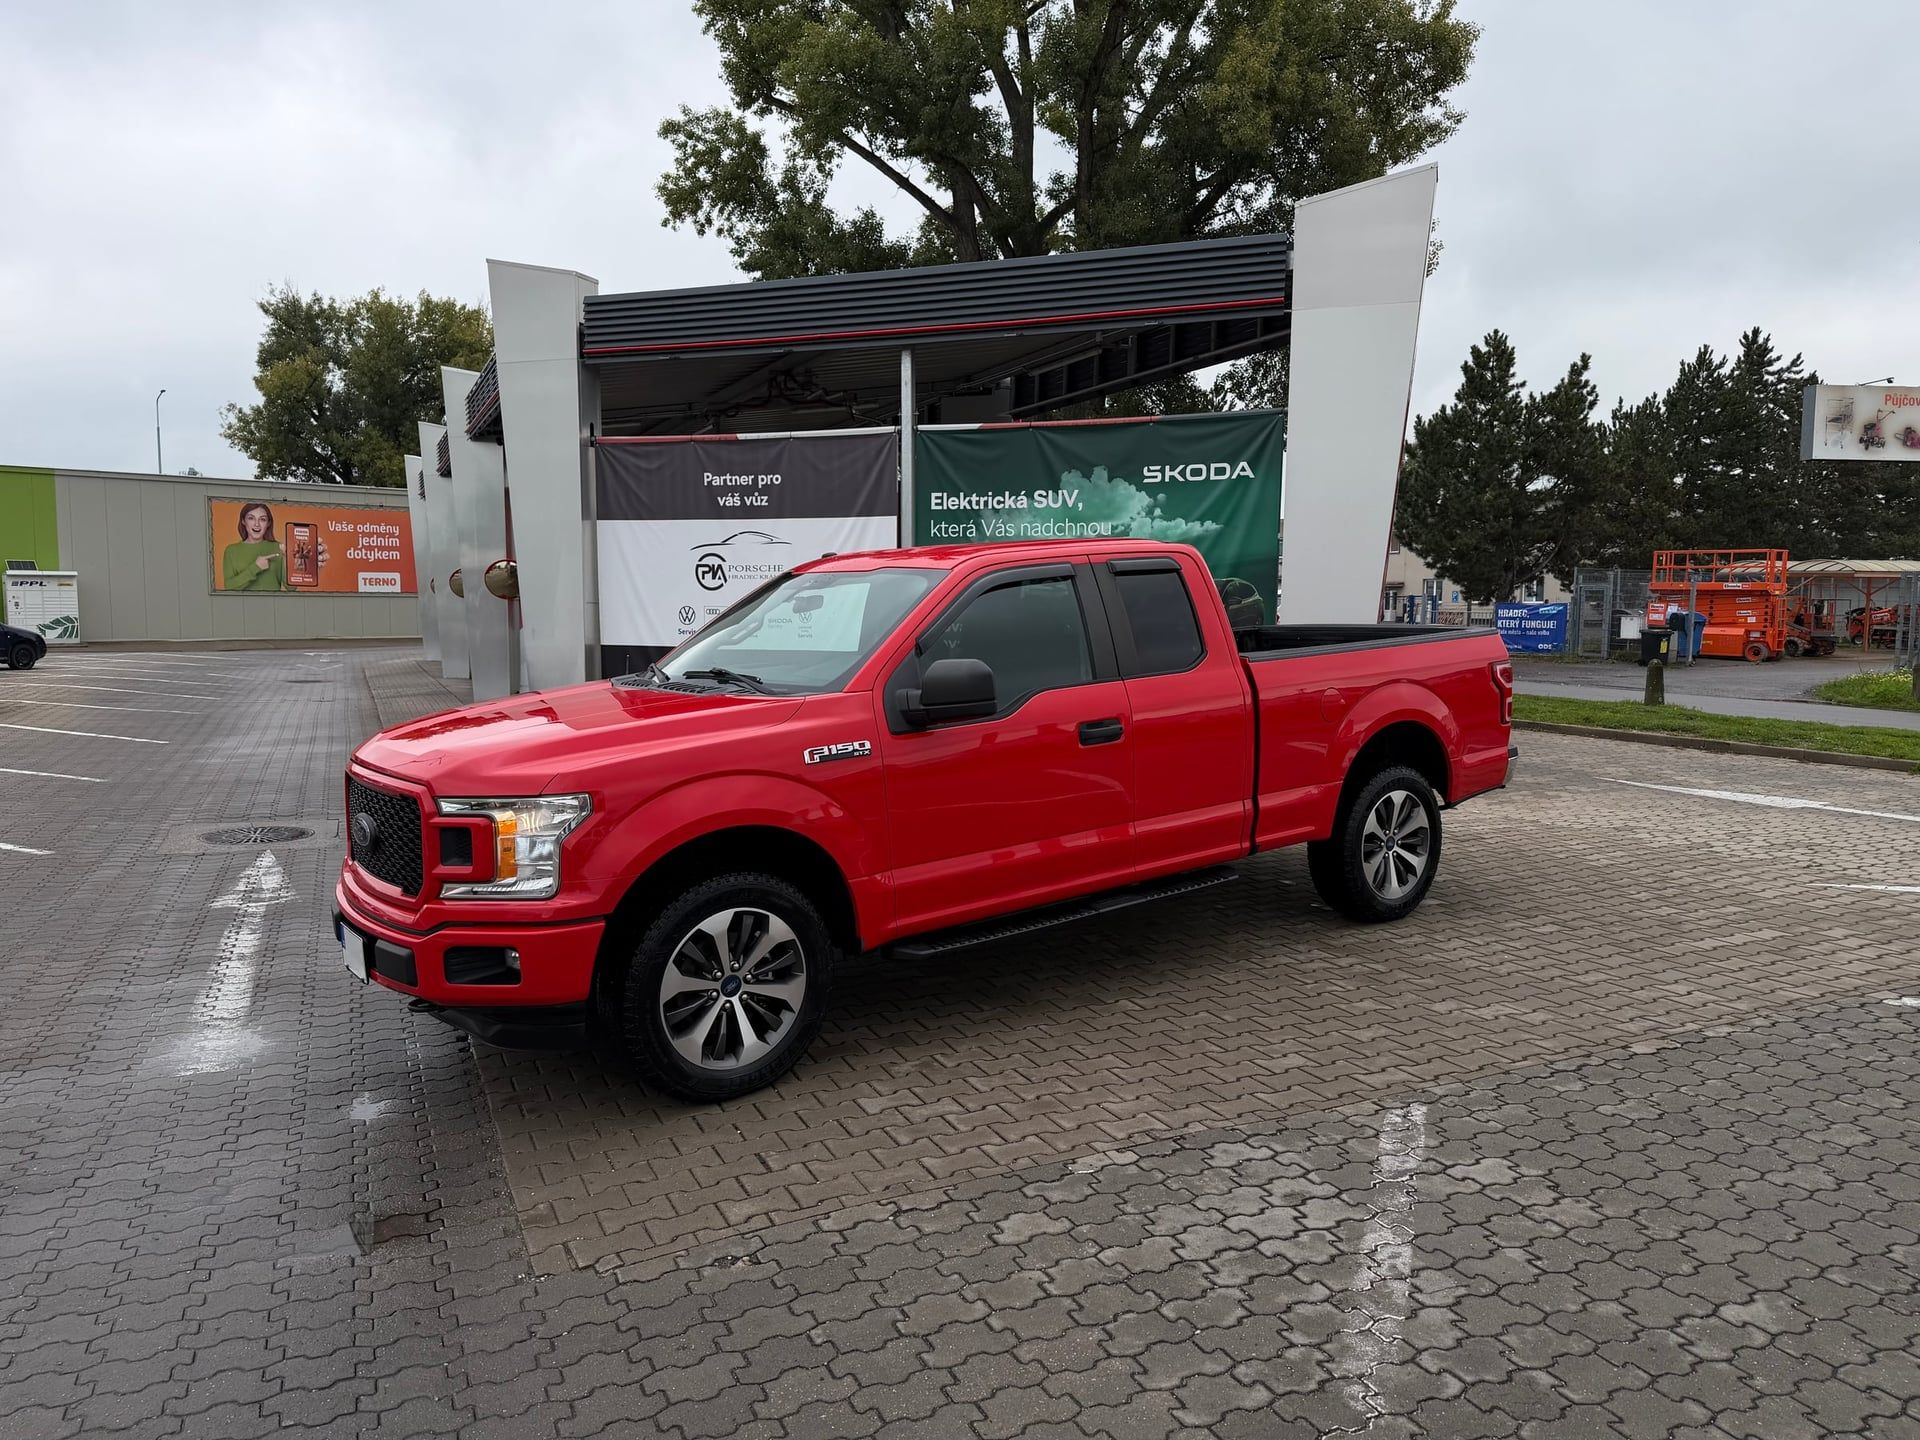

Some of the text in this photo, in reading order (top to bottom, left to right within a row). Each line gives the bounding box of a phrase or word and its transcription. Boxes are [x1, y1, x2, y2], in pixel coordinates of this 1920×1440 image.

[703, 472, 782, 489] Partner pro
[717, 491, 769, 507] váš vůz
[930, 489, 1084, 511] Elektrická SUV,
[327, 520, 400, 536] Vaše odměny
[930, 518, 1112, 538] která Vás nadchnou
[358, 534, 400, 548] jedním
[346, 547, 400, 562] dotykem
[728, 564, 785, 573] PORSCHE
[361, 577, 397, 586] TERNO
[1497, 618, 1557, 629] KTERÝ FUNGUJE!
